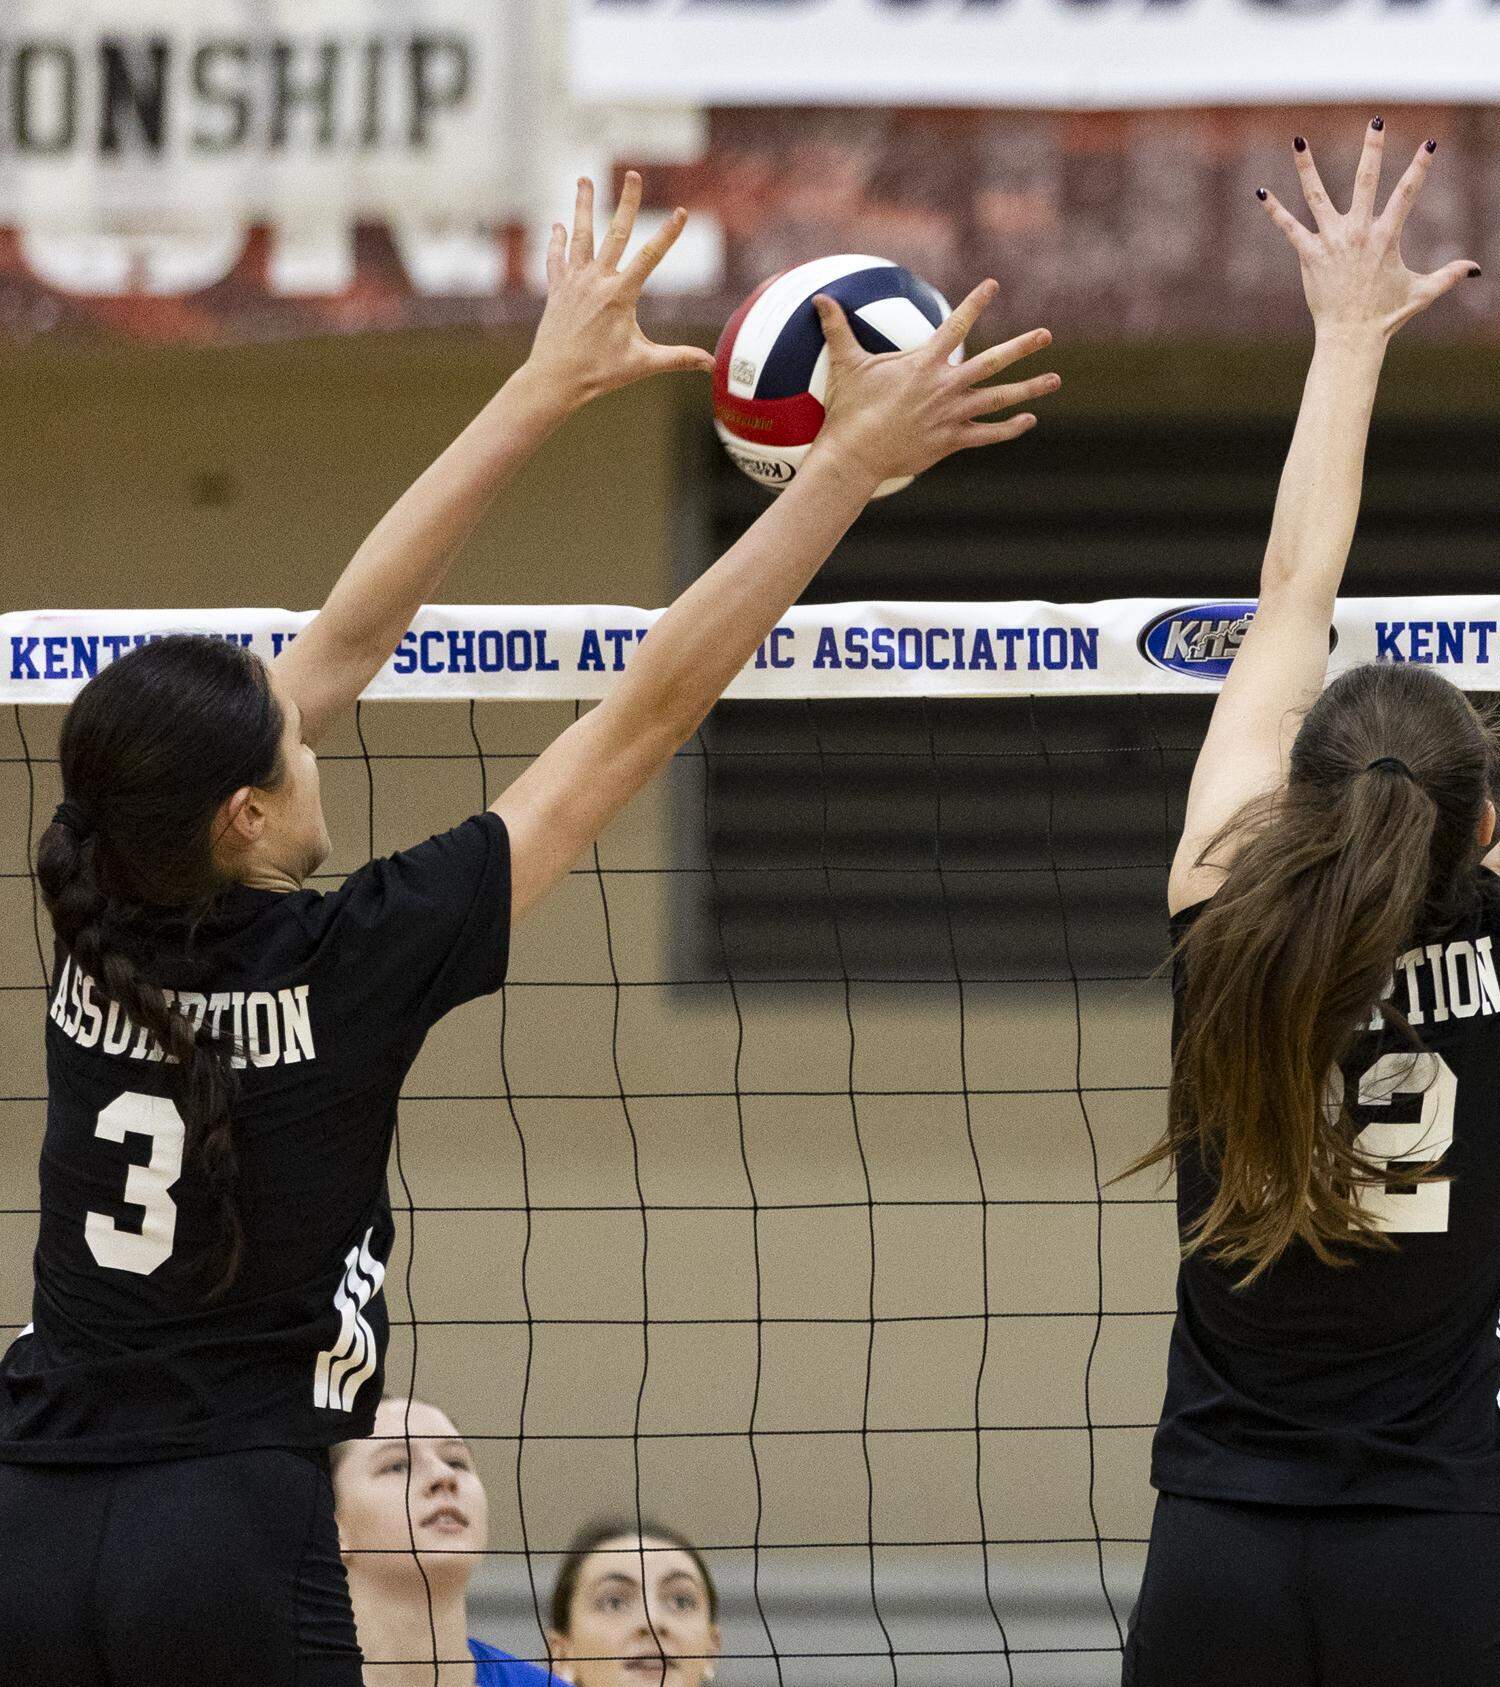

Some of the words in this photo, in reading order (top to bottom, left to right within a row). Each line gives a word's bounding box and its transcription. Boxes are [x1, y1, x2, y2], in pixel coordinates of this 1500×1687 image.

[10, 634, 253, 680] KENT
[393, 629, 559, 674] SCHOOL
[577, 627, 795, 672] ATIC
[812, 626, 1099, 671] ASSOCIATION
[84, 1091, 186, 1276] 3
[1320, 1052, 1458, 1233] 2
